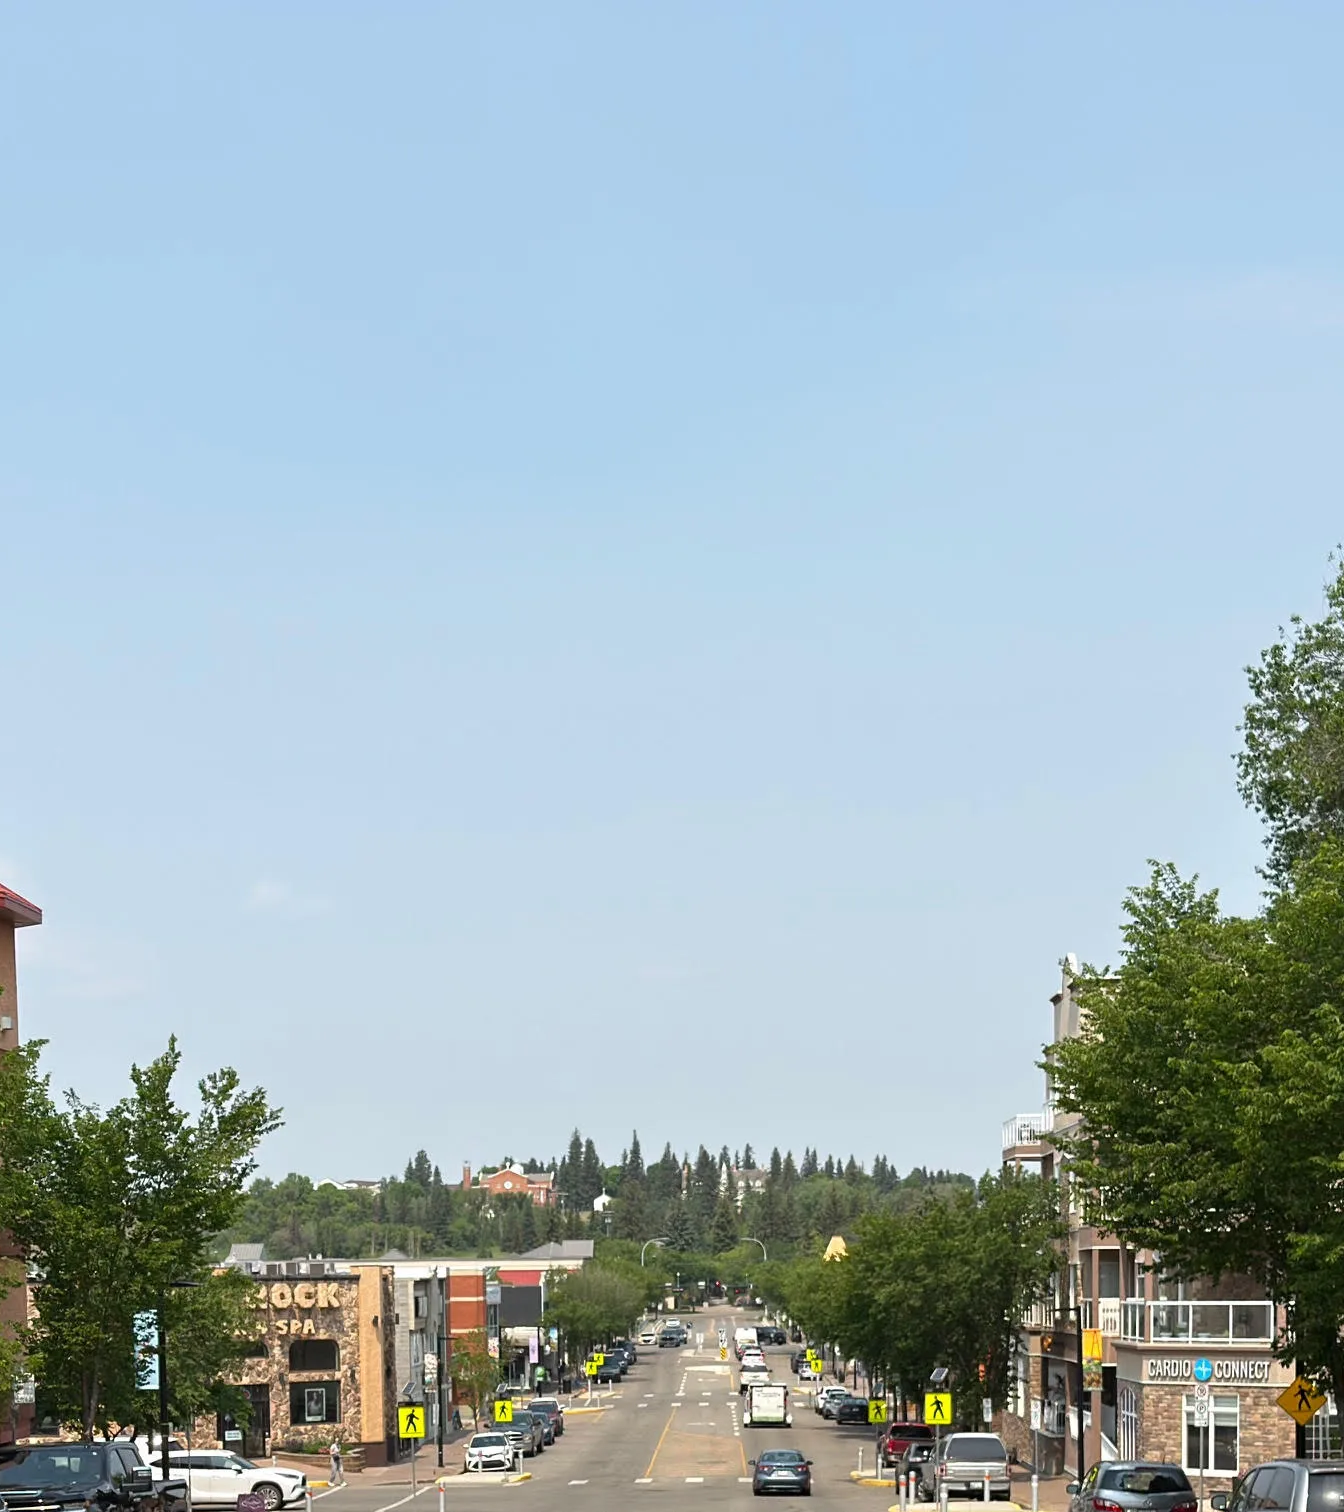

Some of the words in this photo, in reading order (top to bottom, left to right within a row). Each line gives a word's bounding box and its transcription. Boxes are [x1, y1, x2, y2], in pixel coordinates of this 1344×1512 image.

[275, 1319, 316, 1335] SPA
[1147, 1359, 1191, 1378] CARDIO
[1215, 1360, 1270, 1379] CONNECT
